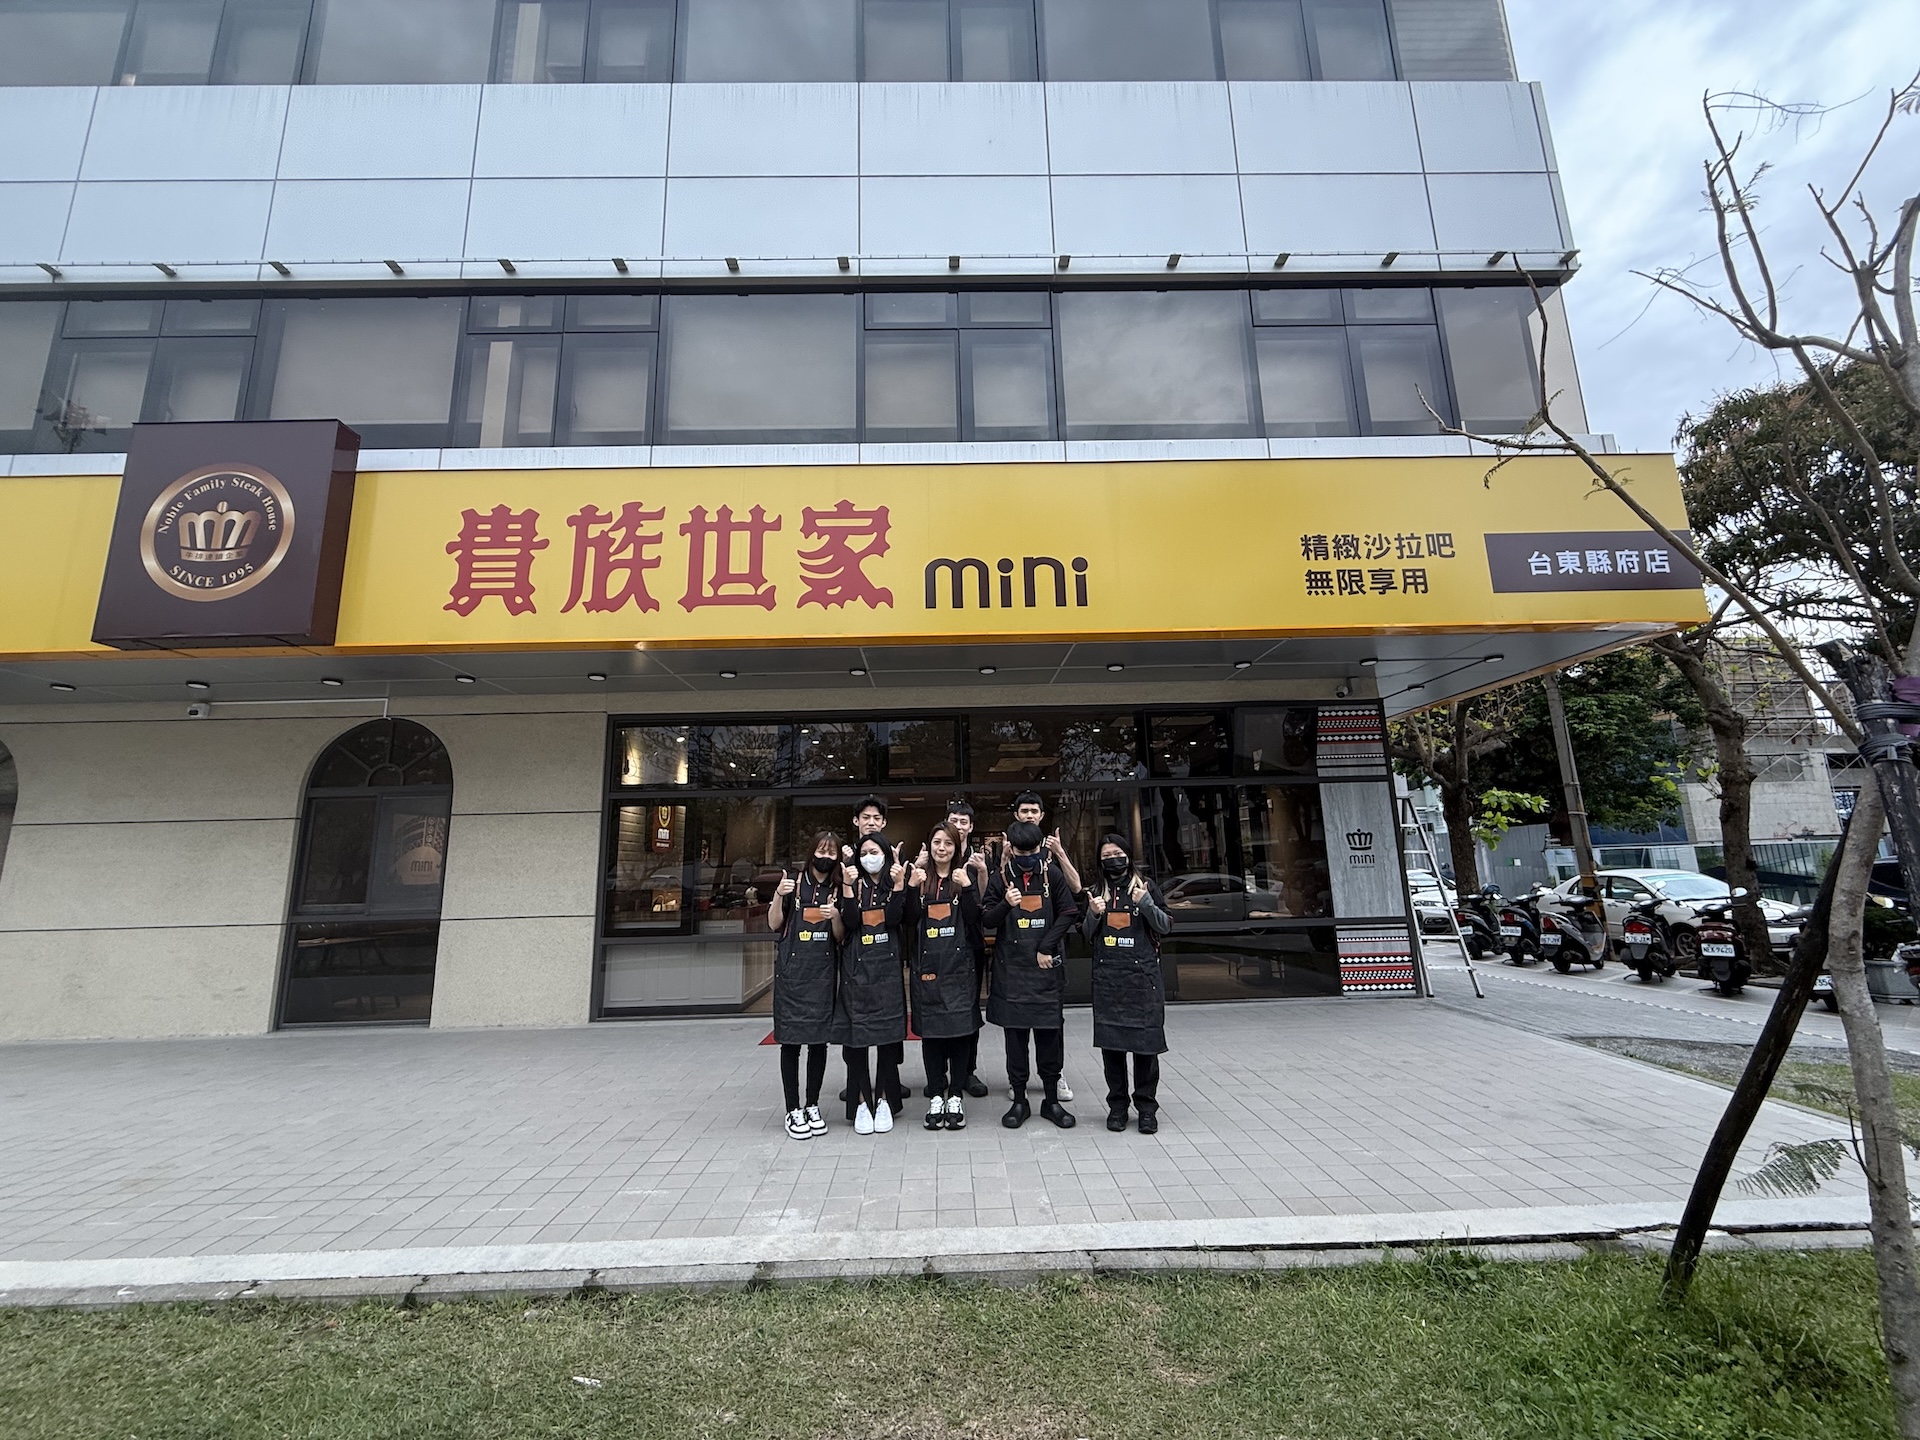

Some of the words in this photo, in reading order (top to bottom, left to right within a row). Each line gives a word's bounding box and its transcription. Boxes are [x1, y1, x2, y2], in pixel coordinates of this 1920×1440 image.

[157, 501, 185, 535] Noble
[184, 478, 227, 501] Family
[230, 477, 264, 498] Steak
[261, 496, 277, 531] House
[442, 499, 895, 617] 貴族世家
[1300, 532, 1456, 562] 精緻沙拉吧
[169, 564, 215, 588] SINCE
[221, 562, 254, 585] 1995
[1527, 548, 1672, 577] 台東縣府店
[924, 556, 1089, 609] mini
[1304, 567, 1430, 597] 無限享用
[1349, 854, 1375, 865] mini
